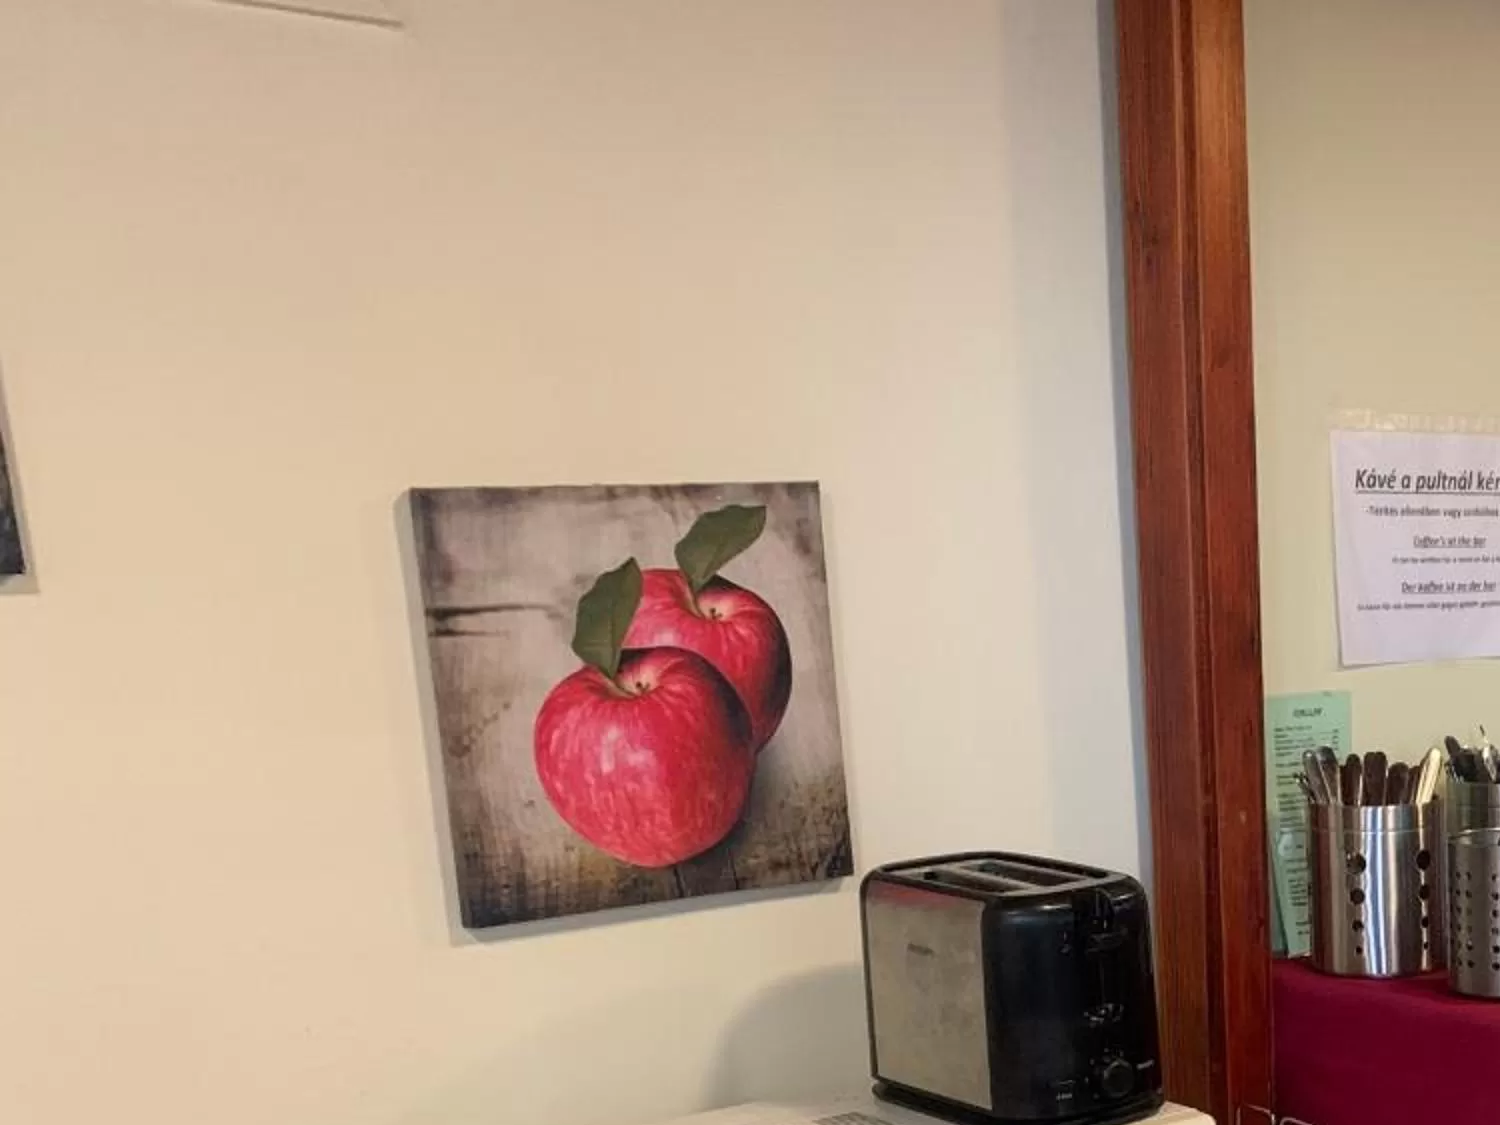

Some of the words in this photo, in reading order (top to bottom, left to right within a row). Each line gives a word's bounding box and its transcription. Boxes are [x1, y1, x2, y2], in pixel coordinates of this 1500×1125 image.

[1355, 468, 1397, 489] Kávé
[1401, 474, 1411, 489] a
[1415, 469, 1473, 494] pultnál
